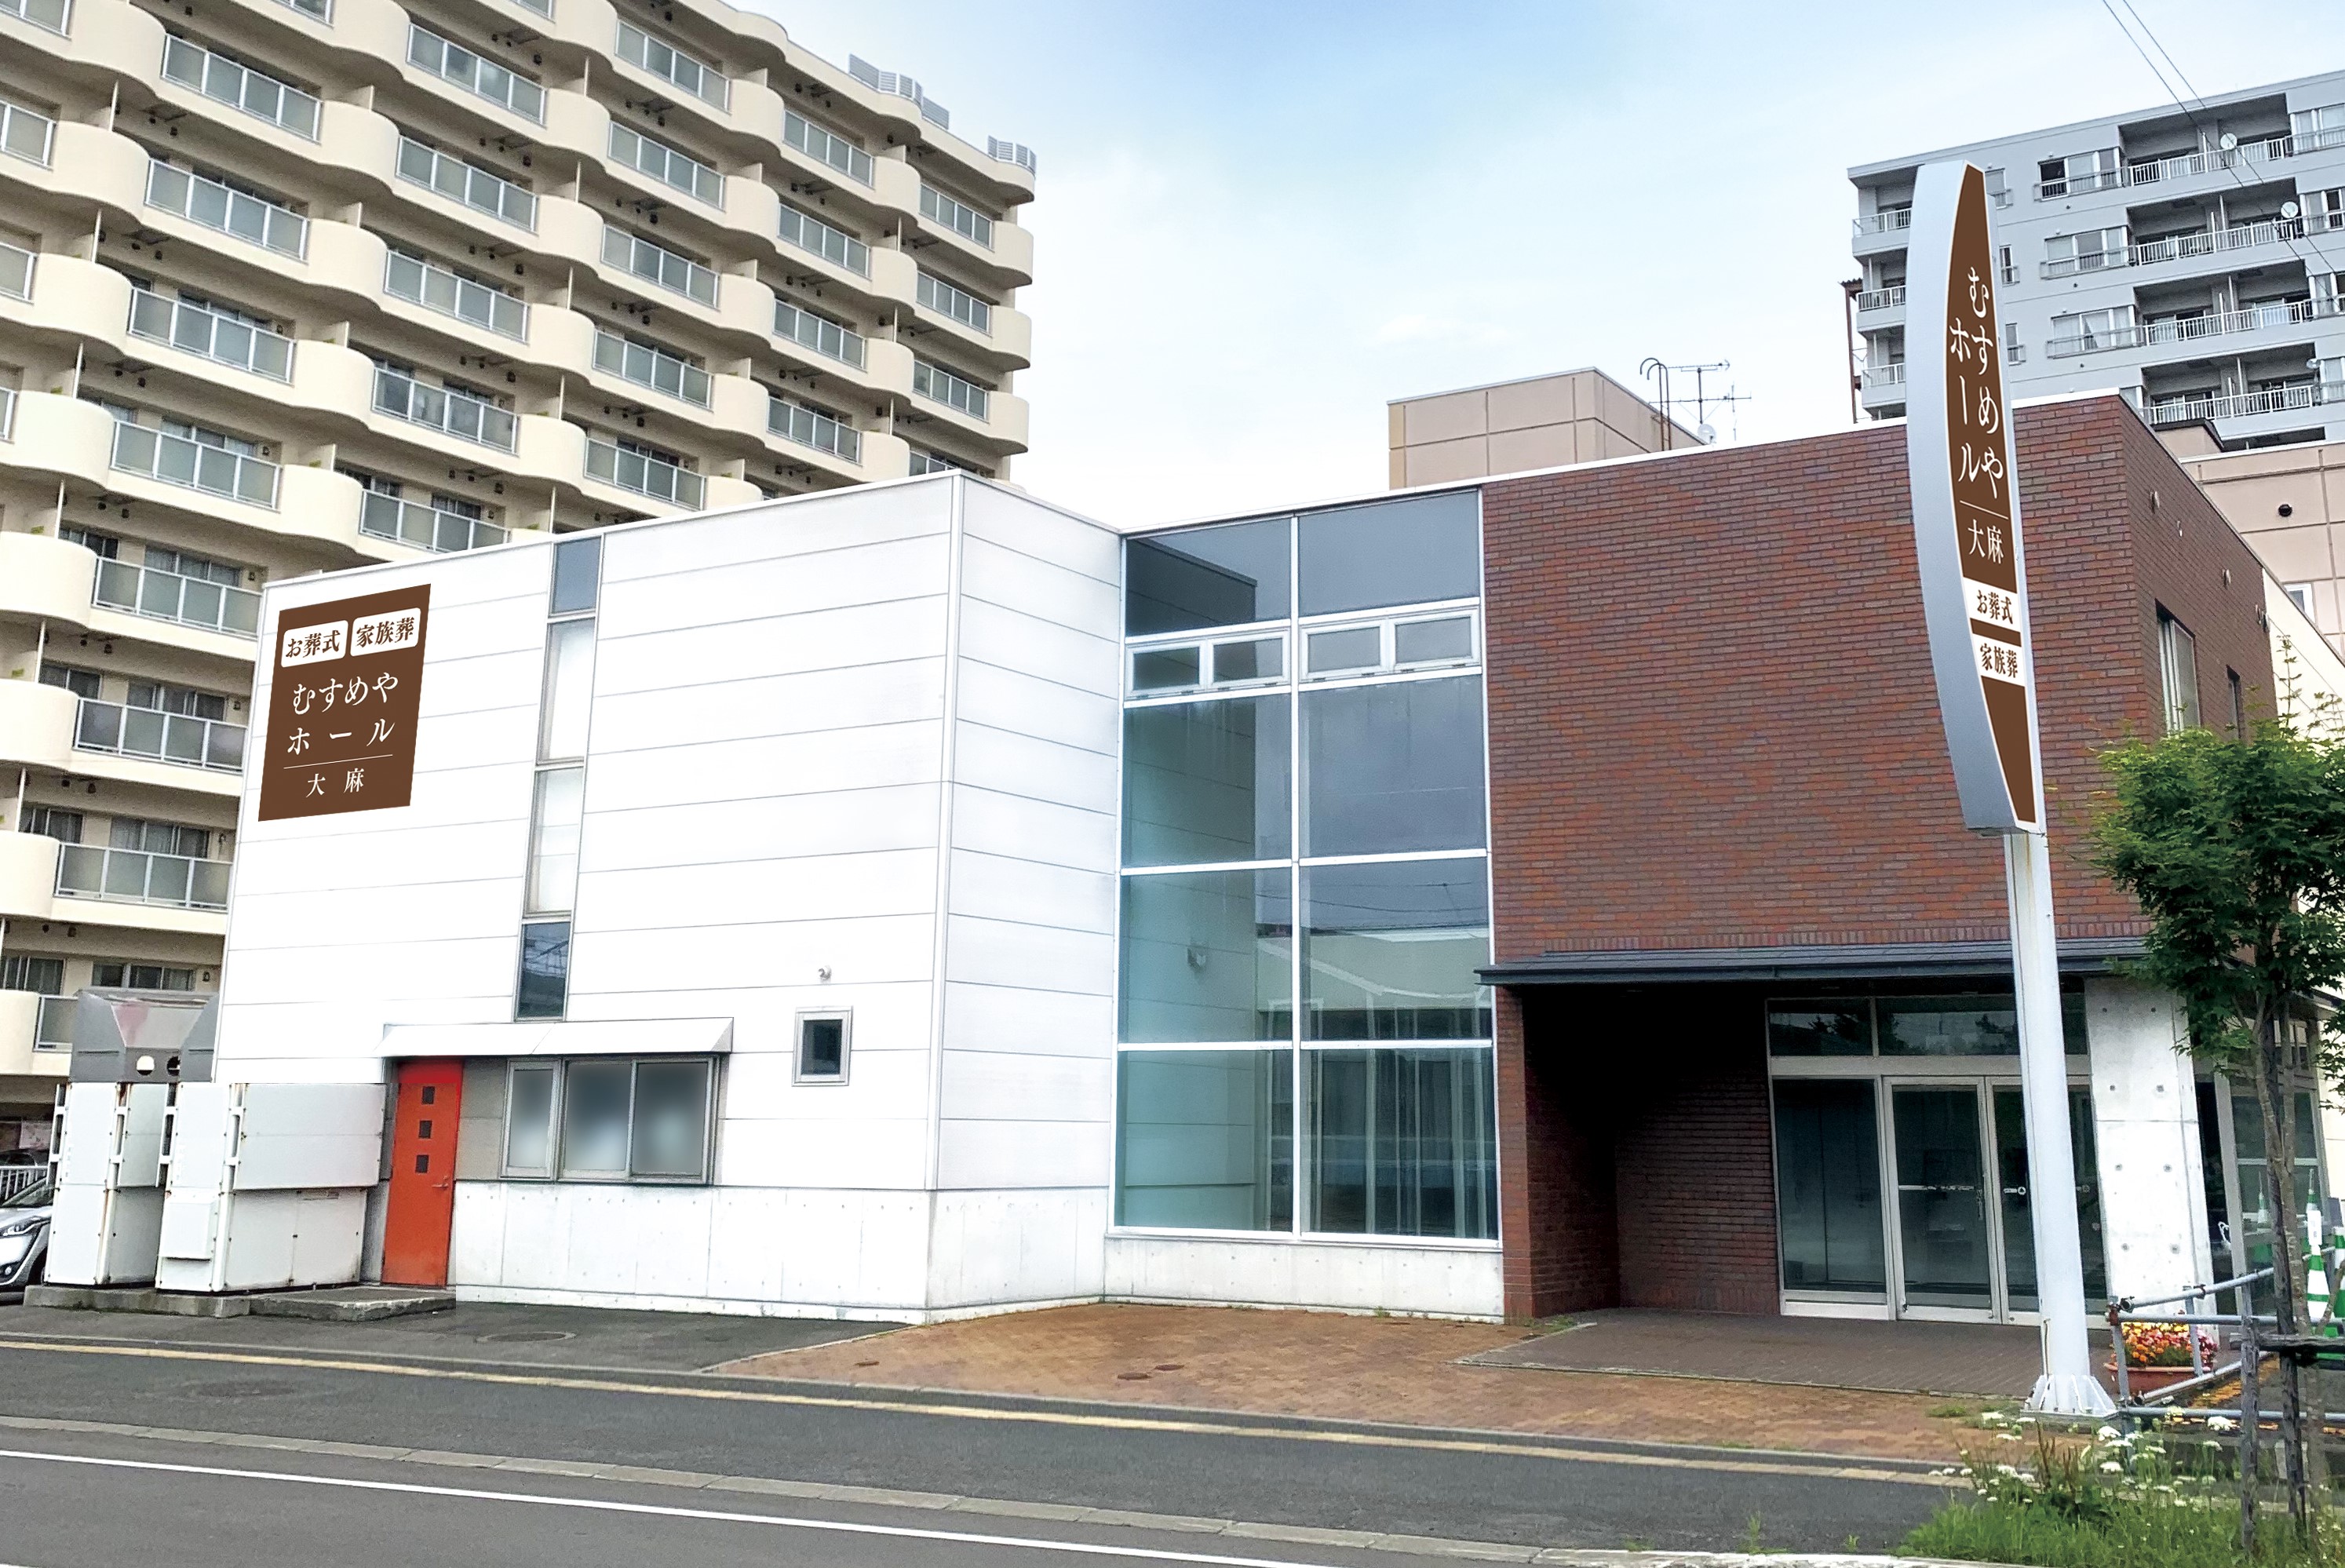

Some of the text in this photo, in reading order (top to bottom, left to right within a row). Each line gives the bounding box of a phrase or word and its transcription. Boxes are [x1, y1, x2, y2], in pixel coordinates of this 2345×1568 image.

[1949, 317, 1981, 483] ホール
[1968, 266, 2004, 499] むすめや
[1968, 519, 2004, 564] 大麻
[1976, 589, 2014, 625] お葬式
[285, 629, 341, 658] お葬式
[356, 616, 415, 647] 家族葬
[1979, 643, 2019, 679] 家族葬
[293, 672, 399, 715] むすめや
[287, 718, 396, 756] ホール
[305, 768, 365, 798] 大麻
